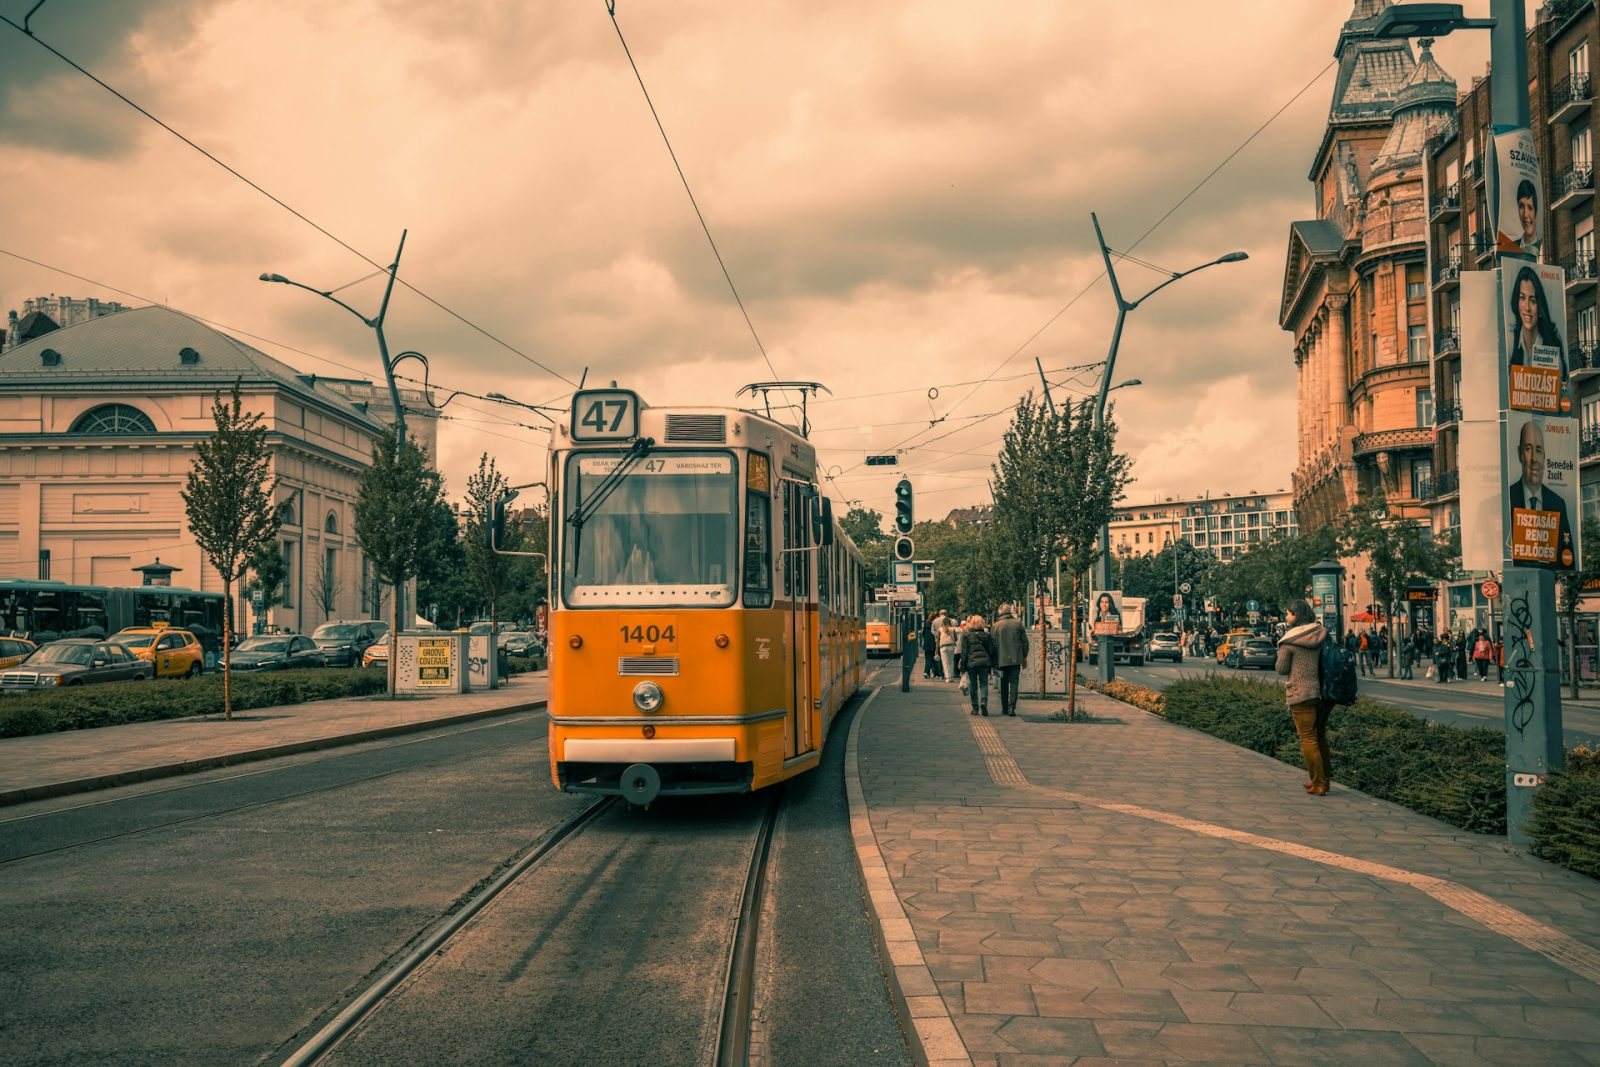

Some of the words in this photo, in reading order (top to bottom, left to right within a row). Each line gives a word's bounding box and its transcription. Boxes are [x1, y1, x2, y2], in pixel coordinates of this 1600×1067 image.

[1513, 368, 1558, 393] VÁLTOZÁST
[1512, 390, 1557, 409] BUDAPESTEN!
[582, 400, 628, 432] 47
[1545, 423, 1564, 434] JÚNIUS
[645, 460, 666, 472] 47
[1547, 459, 1574, 471] Benedek
[1547, 470, 1563, 481] Zsolt
[1516, 512, 1557, 529] TISZTASÁG
[1525, 529, 1549, 542] REND
[1514, 541, 1555, 559] FEJLŐDÉS
[620, 625, 676, 643] 1404
[423, 648, 446, 656] GROOVE
[420, 657, 449, 665] COVERAGE
